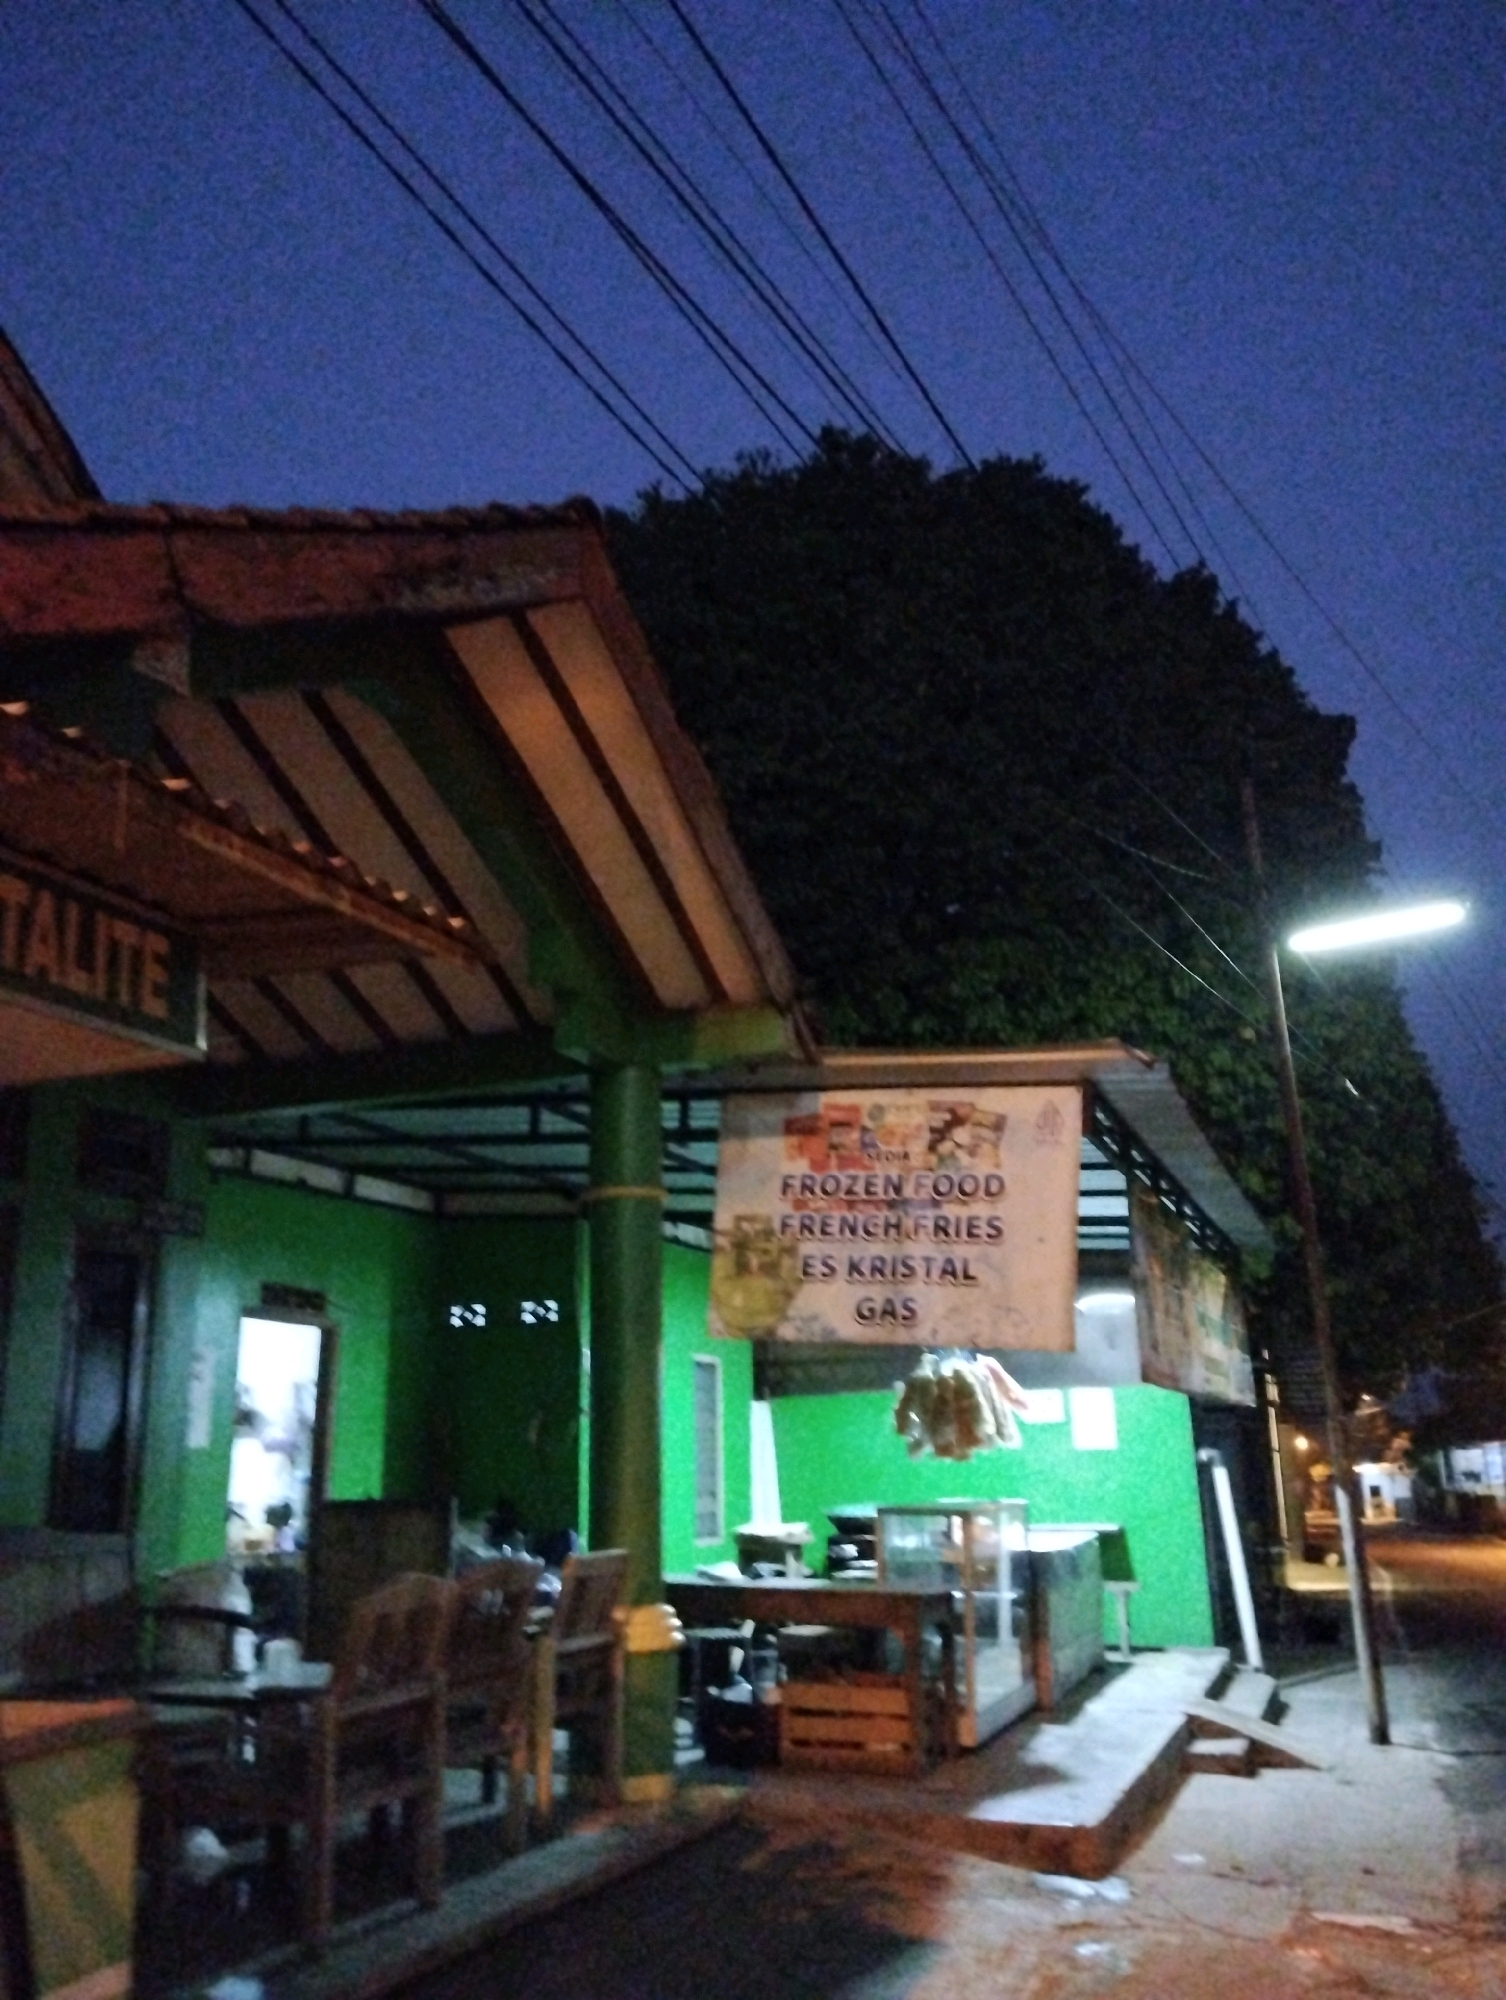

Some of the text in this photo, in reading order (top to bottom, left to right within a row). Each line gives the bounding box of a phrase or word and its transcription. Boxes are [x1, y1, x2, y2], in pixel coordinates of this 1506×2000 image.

[780, 1173, 1006, 1199] FROZEN FOOD
[779, 1213, 1005, 1241] FRENCH FRIES
[801, 1254, 979, 1284] ES KRISTAL
[855, 1296, 919, 1323] GAS
